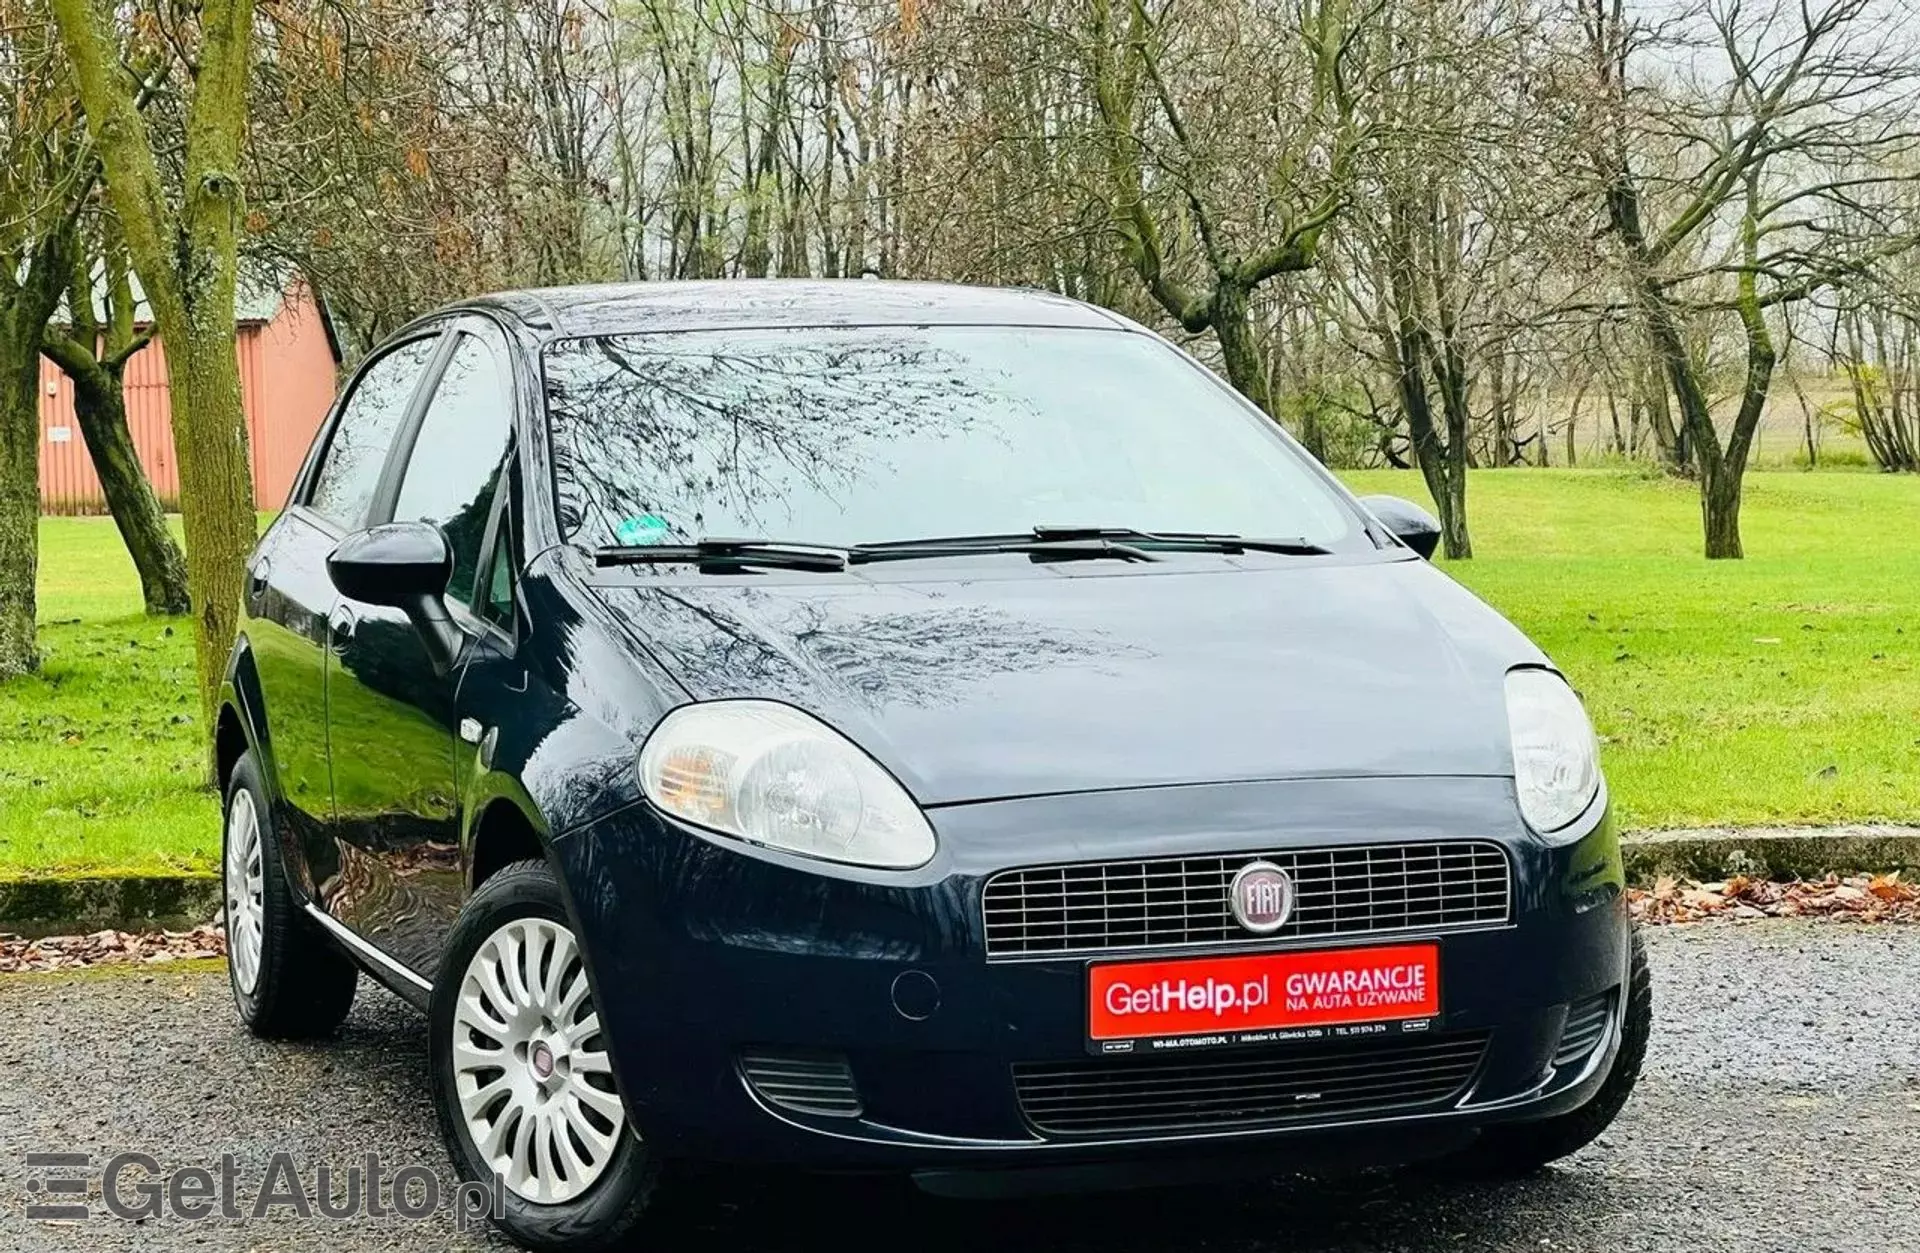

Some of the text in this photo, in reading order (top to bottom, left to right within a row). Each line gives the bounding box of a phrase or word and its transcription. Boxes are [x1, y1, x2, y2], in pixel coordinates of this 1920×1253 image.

[1245, 878, 1281, 914] FIAT
[1105, 974, 1268, 1016] GetHelp.pl
[1286, 964, 1425, 996] GWARANCJE
[1286, 996, 1309, 1011] NA
[1313, 994, 1352, 1010] AUTA
